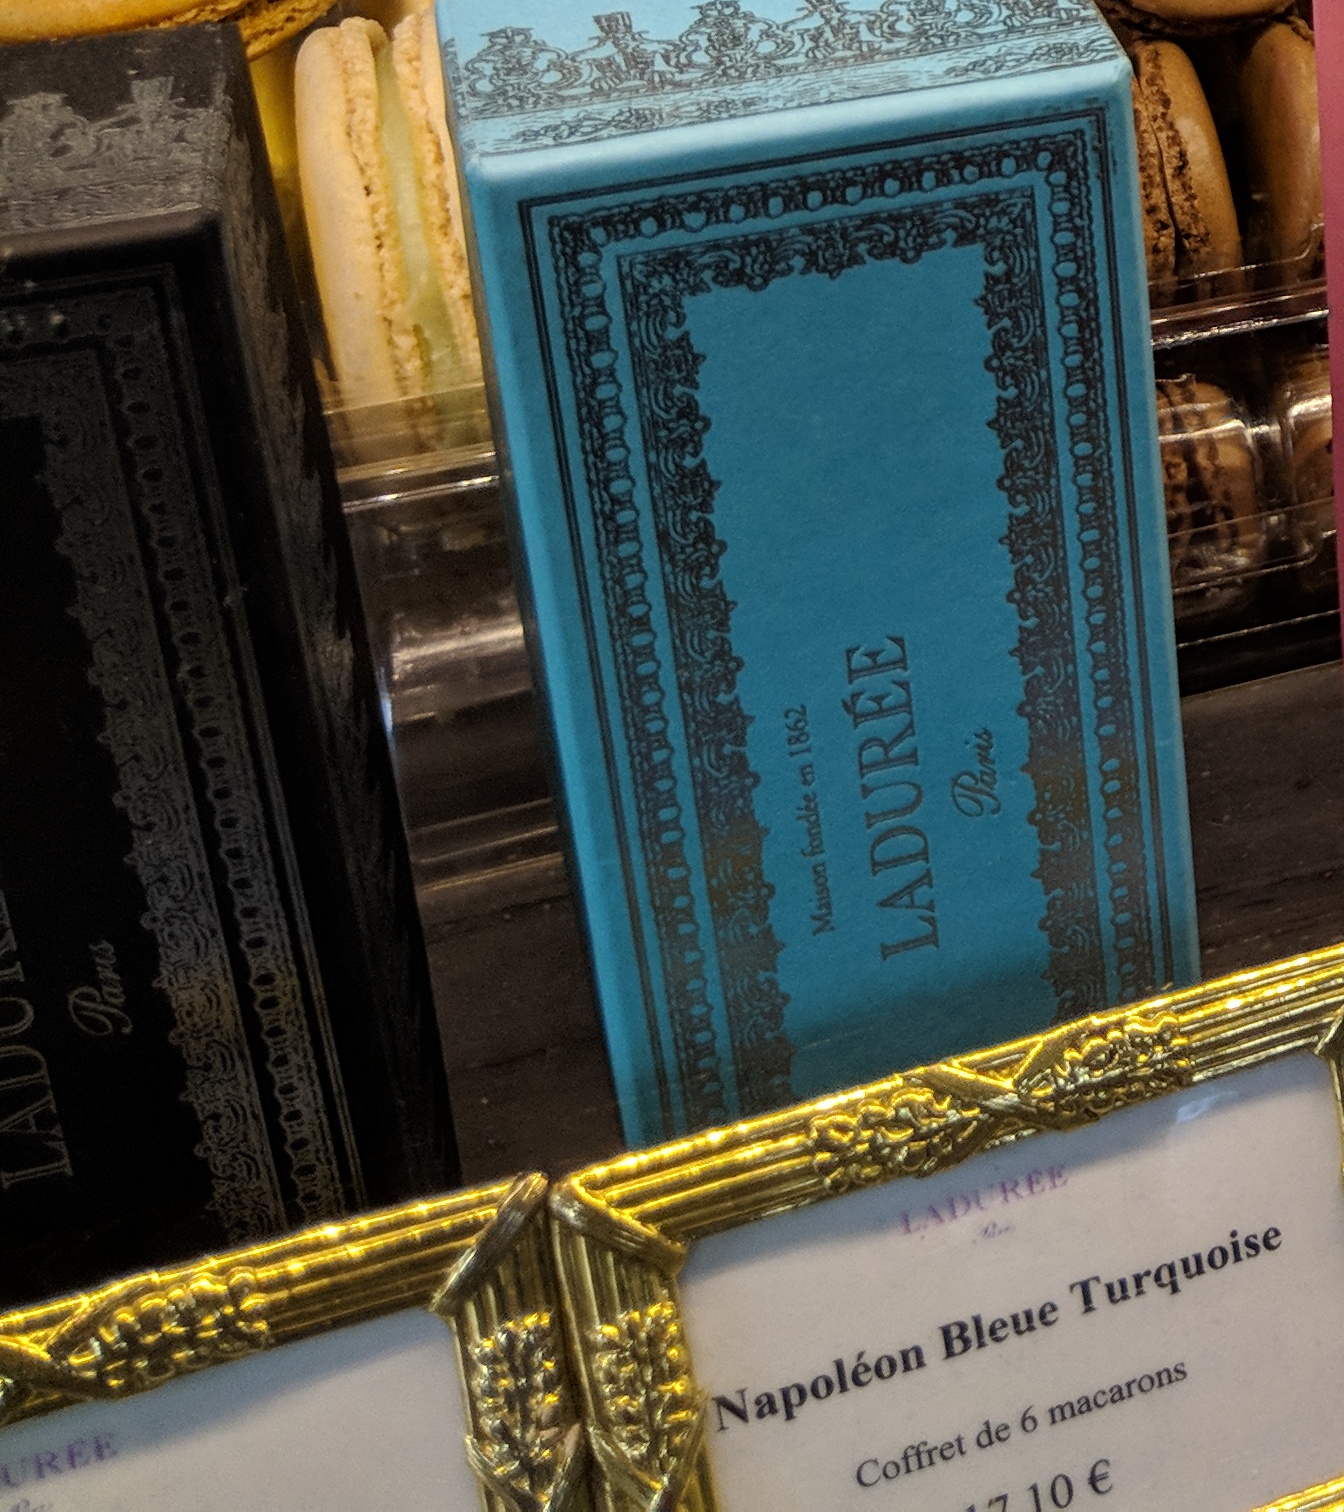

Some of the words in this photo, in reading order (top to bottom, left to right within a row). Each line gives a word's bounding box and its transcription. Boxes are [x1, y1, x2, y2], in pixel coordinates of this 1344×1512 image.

[783, 704, 812, 757] 1862
[799, 763, 817, 787] en
[951, 727, 1001, 818] Paris
[841, 635, 940, 961] LADURÉE
[810, 861, 835, 937] Maison
[68, 940, 133, 1036] Paris
[713, 1342, 926, 1433] Napoléon
[938, 1302, 1059, 1362] Bleue
[1069, 1225, 1283, 1317] Turquoise
[855, 1433, 967, 1489] Coffret
[975, 1421, 1011, 1452] de
[1020, 1404, 1039, 1435] 6
[1048, 1362, 1189, 1426] macarons
[1087, 1458, 1113, 1494] €
